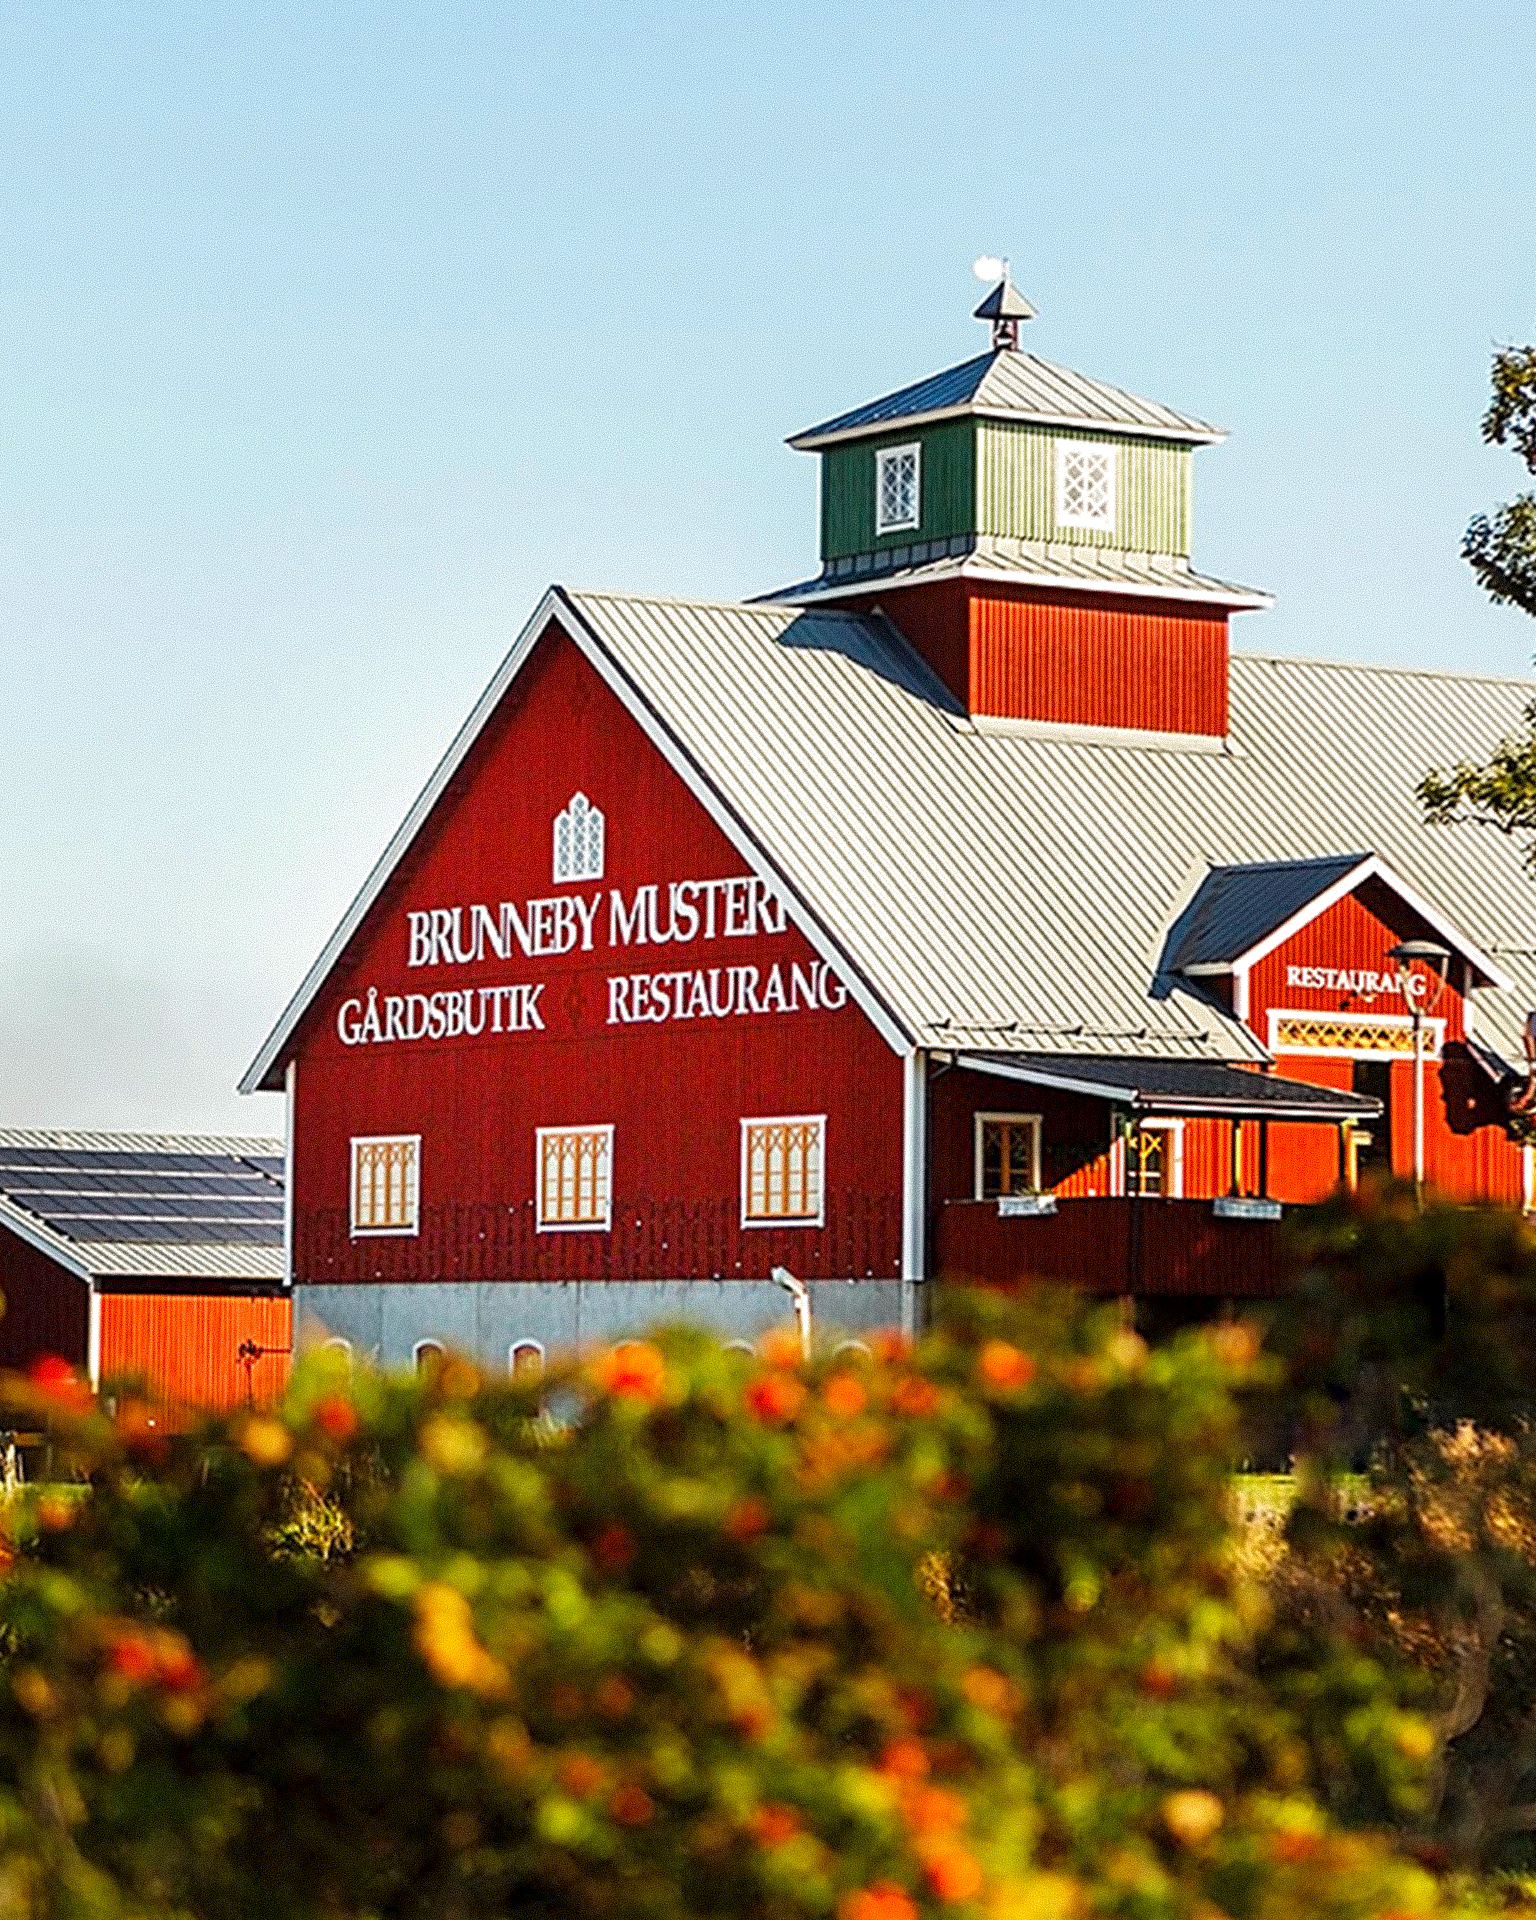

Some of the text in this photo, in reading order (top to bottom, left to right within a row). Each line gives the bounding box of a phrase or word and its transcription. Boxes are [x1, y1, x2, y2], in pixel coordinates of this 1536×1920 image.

[407, 893, 602, 967] BRUNNEBY
[337, 960, 848, 1045] GÅRDSBUTIK RESTAURANG
